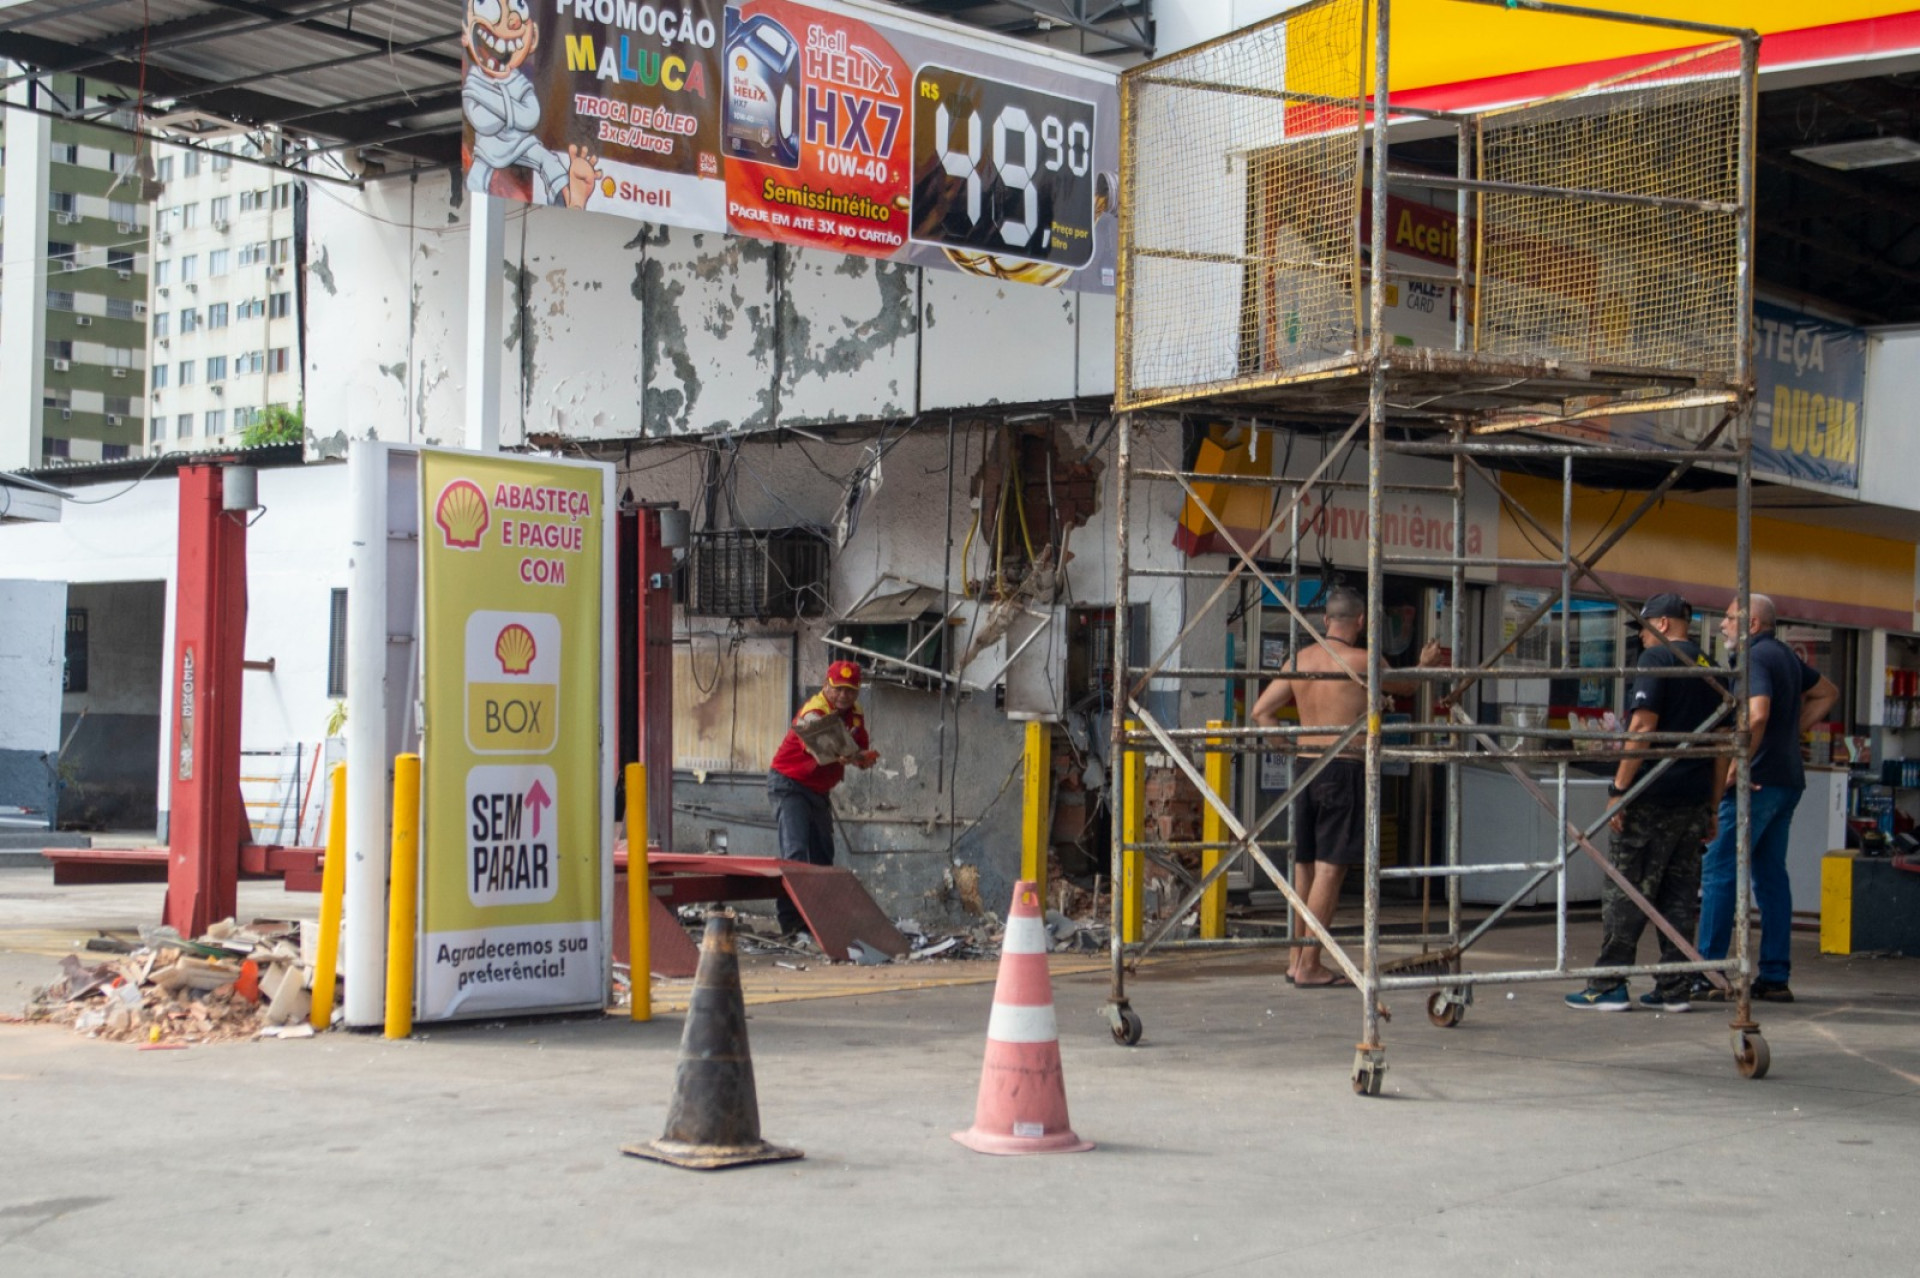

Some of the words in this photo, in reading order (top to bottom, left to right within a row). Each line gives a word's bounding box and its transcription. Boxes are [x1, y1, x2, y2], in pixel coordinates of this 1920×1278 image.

[808, 25, 846, 53] Shell
[565, 35, 706, 99] MALUCA
[805, 46, 899, 97] HELIX
[734, 85, 768, 102] HELIX
[575, 93, 628, 123] TROCA
[630, 104, 653, 128] DE
[653, 104, 697, 137] ÓLEO
[805, 84, 903, 160] HX7
[817, 150, 888, 184] 10W-40
[620, 181, 671, 208] Shell
[763, 178, 890, 223] Semissintético
[729, 202, 769, 223] PAGUE
[772, 213, 790, 227] EM
[793, 217, 815, 231] ATÉ
[817, 218, 836, 236] 3X
[839, 224, 857, 239] NO
[858, 227, 902, 247] CARTÃO
[1406, 294, 1435, 314] CARD
[1771, 384, 1856, 464] DUCHA
[494, 484, 591, 521] ABASTEÇA
[503, 521, 512, 545] E
[518, 524, 583, 551] PAGUE
[1293, 492, 1482, 554] Convniênca
[520, 558, 566, 584] COM
[486, 699, 542, 734] BOX
[472, 793, 523, 842] SEM
[473, 843, 549, 893] PARAR
[437, 938, 553, 967] Agradecemos
[558, 936, 588, 952] sua
[458, 957, 566, 991] preferência!
